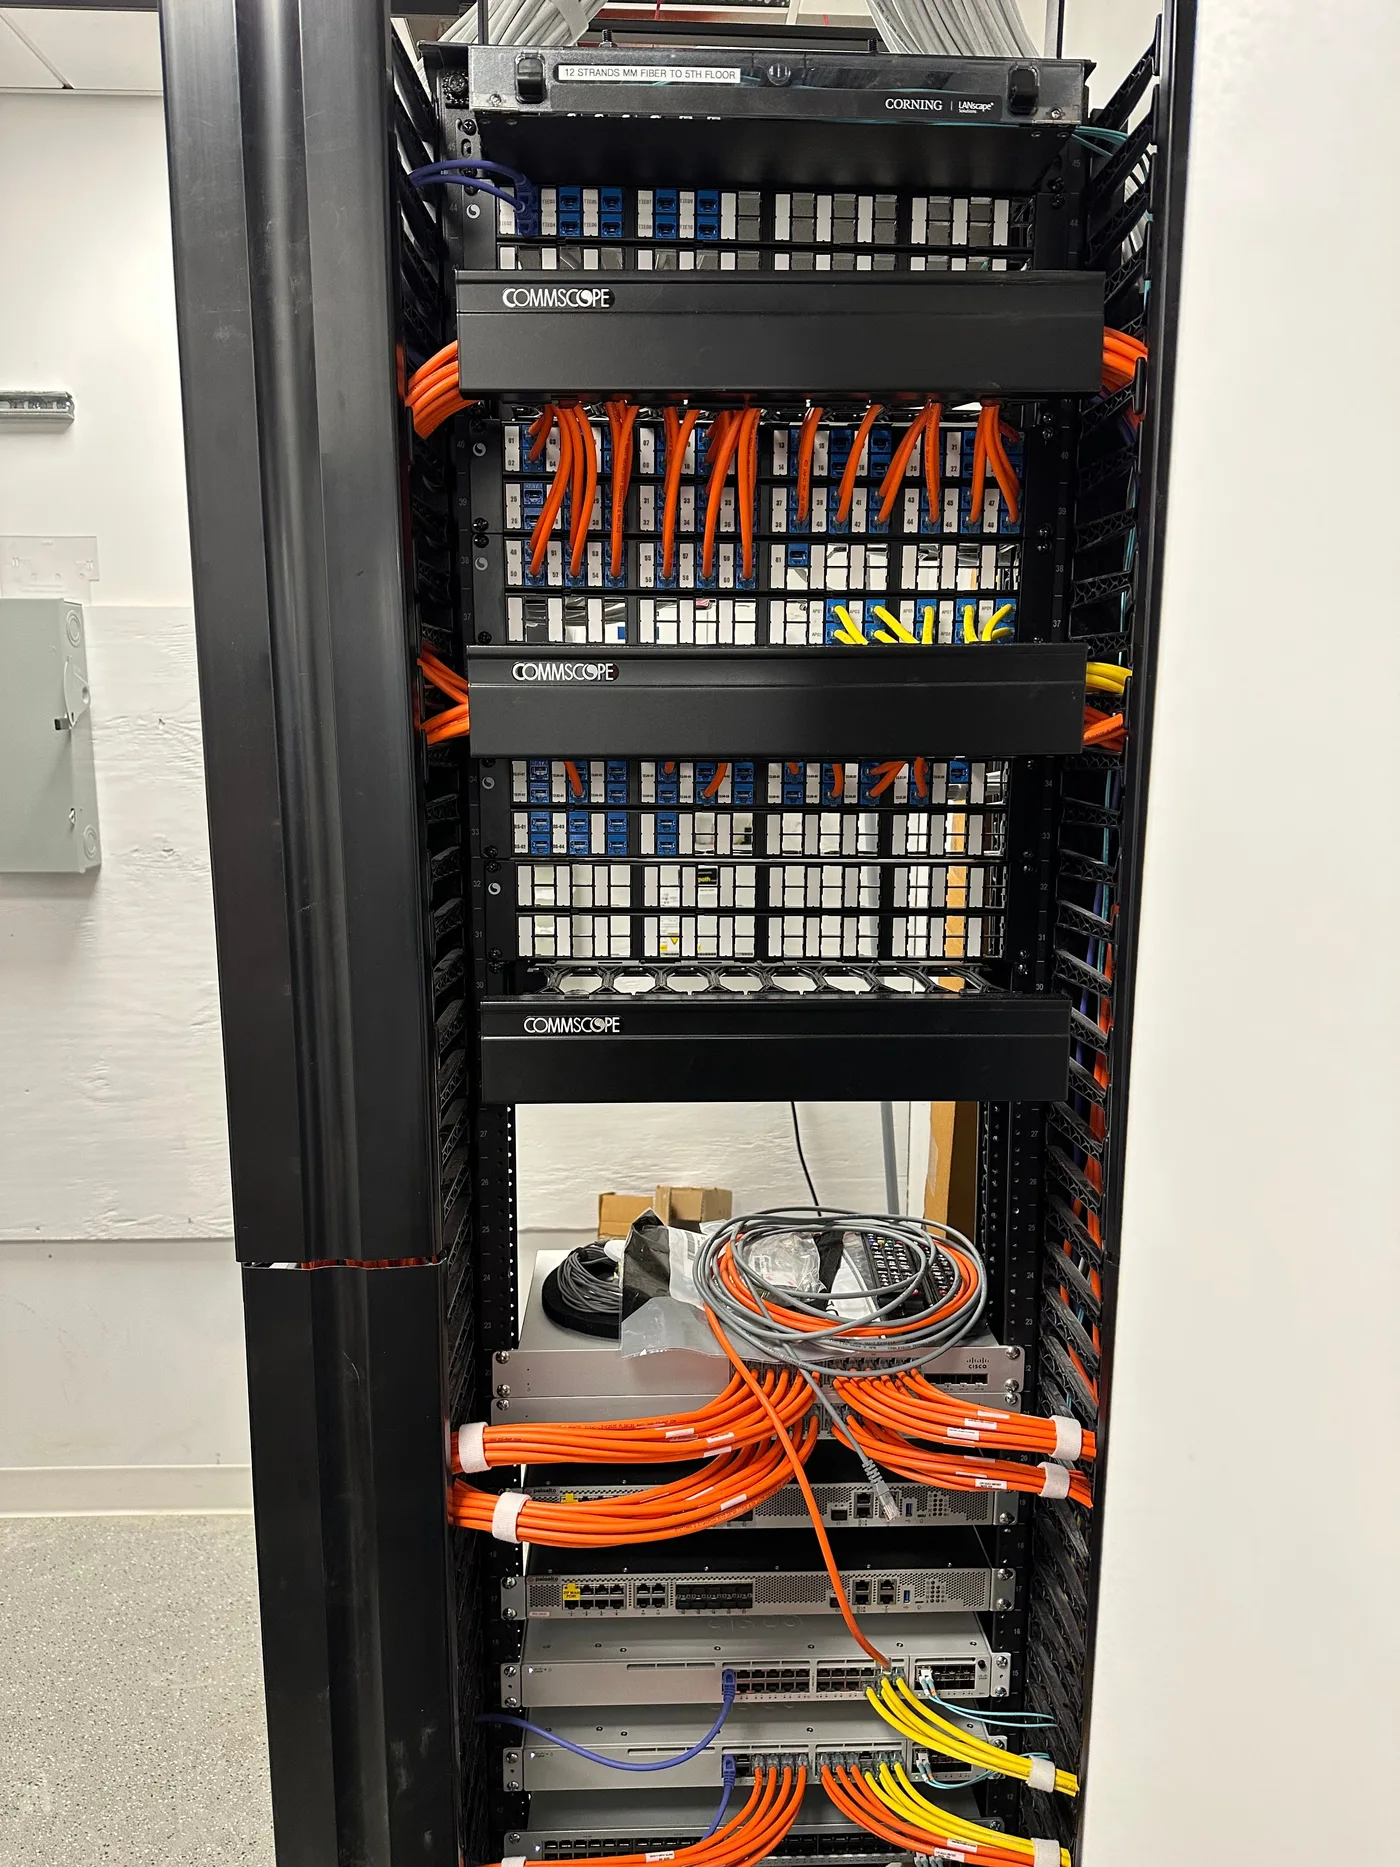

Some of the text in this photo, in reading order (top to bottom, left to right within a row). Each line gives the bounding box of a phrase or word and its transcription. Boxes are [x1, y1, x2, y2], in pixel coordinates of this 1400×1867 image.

[565, 69, 736, 80] 12 STRANDS MM FIBER TO 5TH FLOOR
[885, 98, 943, 111] CORNING
[502, 288, 610, 308] COMMSCOPE
[512, 662, 614, 681] COMMSCOPE
[523, 1017, 620, 1033] COMMSCOPE
